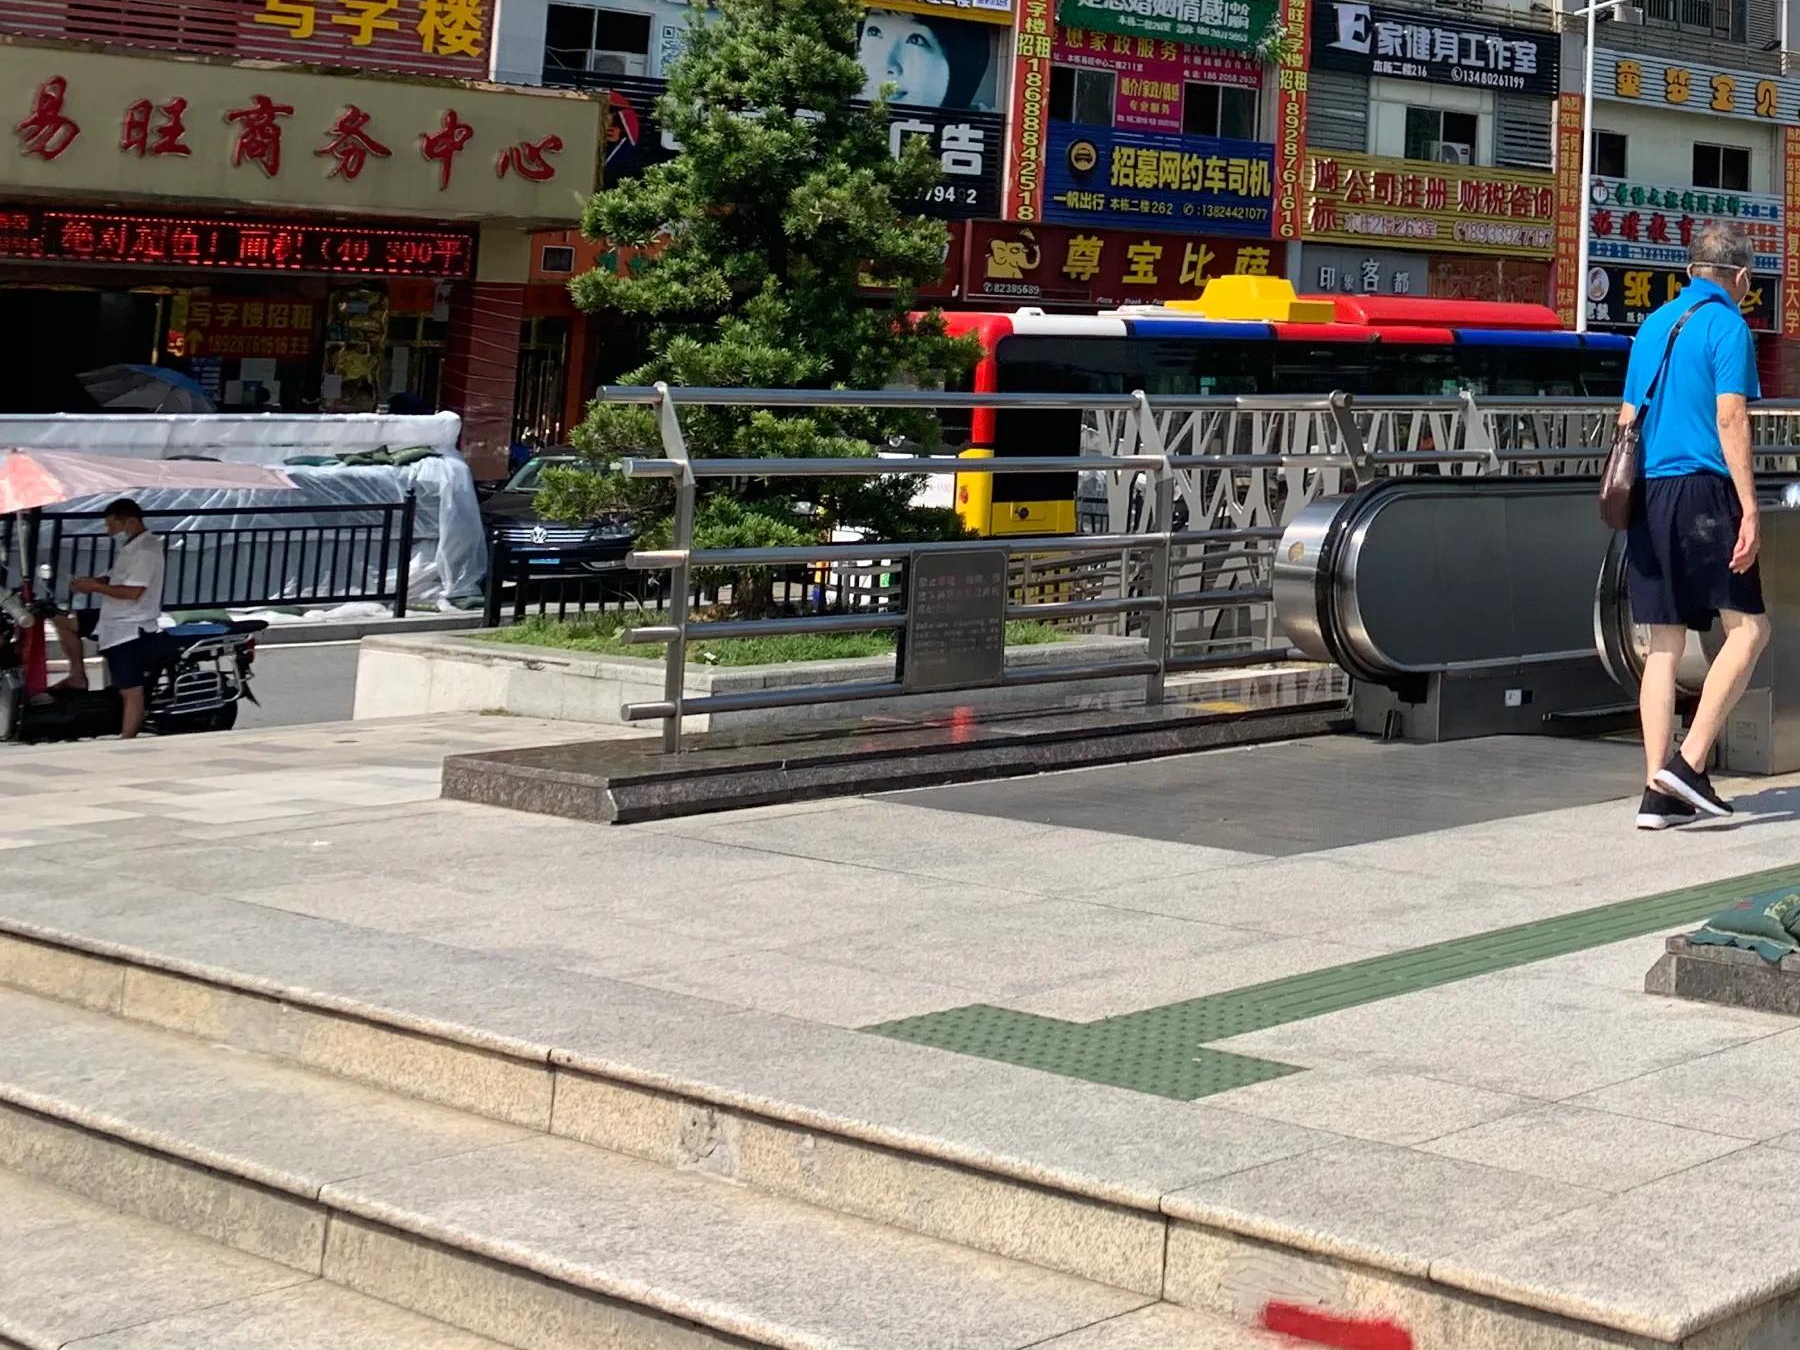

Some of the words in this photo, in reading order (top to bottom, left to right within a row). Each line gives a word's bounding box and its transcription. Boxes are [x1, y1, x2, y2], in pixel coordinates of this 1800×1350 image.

[1017, 34, 1051, 58] 招租
[1280, 70, 1308, 92] 招租
[1462, 69, 1525, 90] 13480261199
[16, 73, 566, 191] 易旺商务中心
[1110, 145, 1271, 198] 招募网约车司机
[1343, 168, 1447, 210] 公司注册
[1457, 180, 1554, 218] 财税咨询
[1062, 233, 1271, 288] 尊宝比萨
[1319, 257, 1410, 294] 印象客都
[993, 283, 1040, 296] 82385689
[1785, 233, 1800, 334] 复旦大学
[188, 301, 313, 330] 写字楼招租
